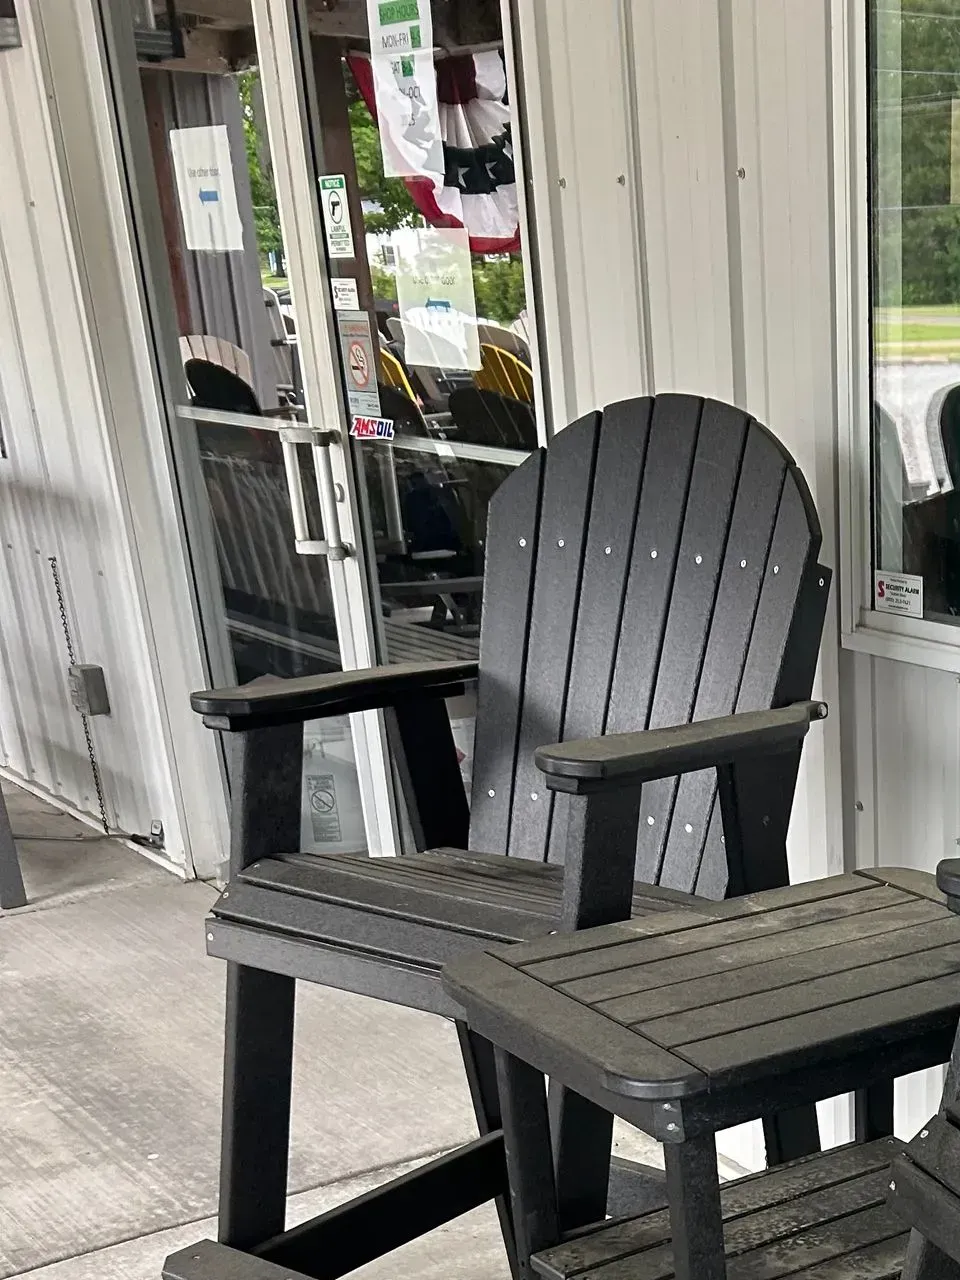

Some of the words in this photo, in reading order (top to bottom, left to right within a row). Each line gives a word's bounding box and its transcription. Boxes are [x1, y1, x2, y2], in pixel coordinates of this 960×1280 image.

[396, 4, 419, 19] HOURS
[381, 32, 409, 48] MON-FRI
[187, 167, 196, 178] Use
[352, 418, 393, 438] AMSOIL
[885, 583, 904, 592] SECURITY
[904, 587, 920, 595] ALARM
